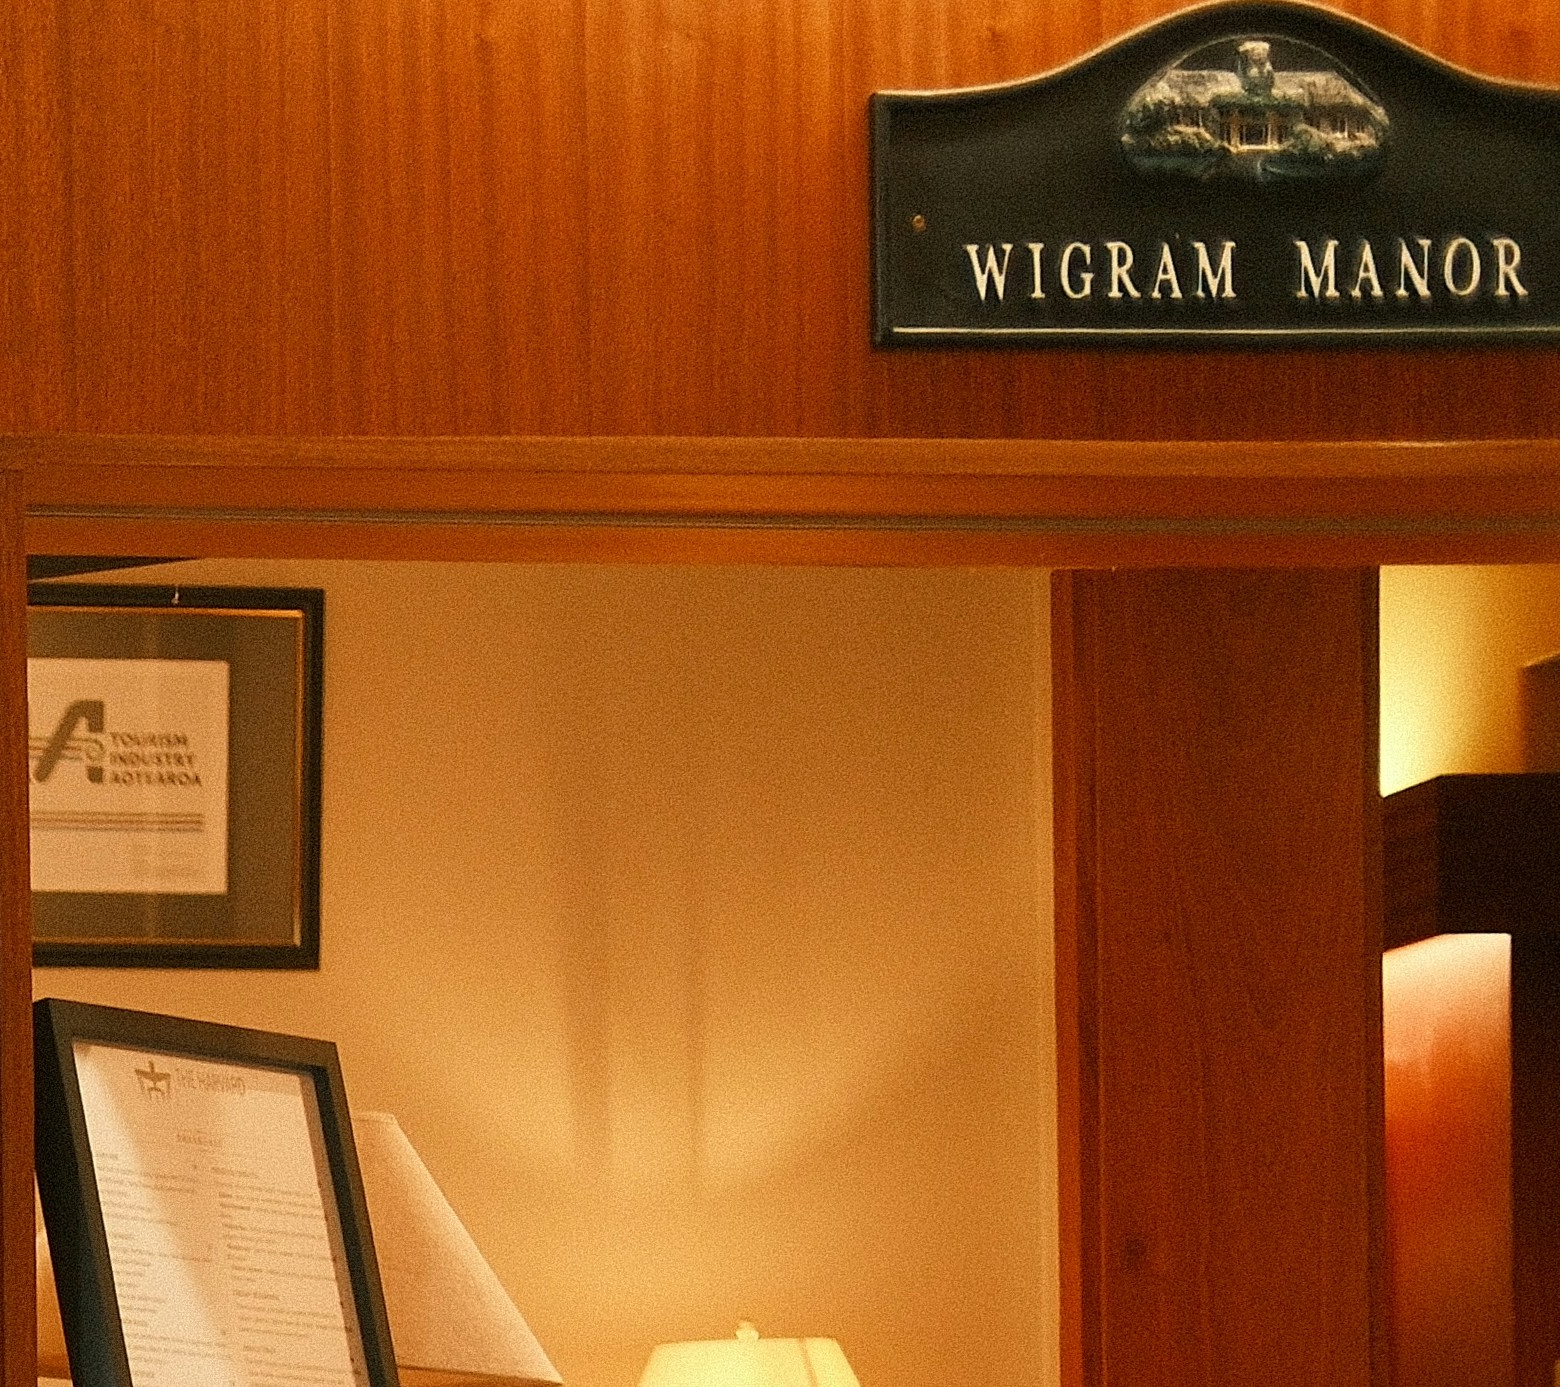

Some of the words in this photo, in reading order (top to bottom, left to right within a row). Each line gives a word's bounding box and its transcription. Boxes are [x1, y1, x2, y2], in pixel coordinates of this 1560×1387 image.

[966, 240, 1237, 301] WIGRAM
[1294, 236, 1530, 300] MANOR
[109, 731, 188, 747] TOURISM
[109, 752, 195, 768] INDUSTRY
[109, 770, 202, 788] AOTEAROA
